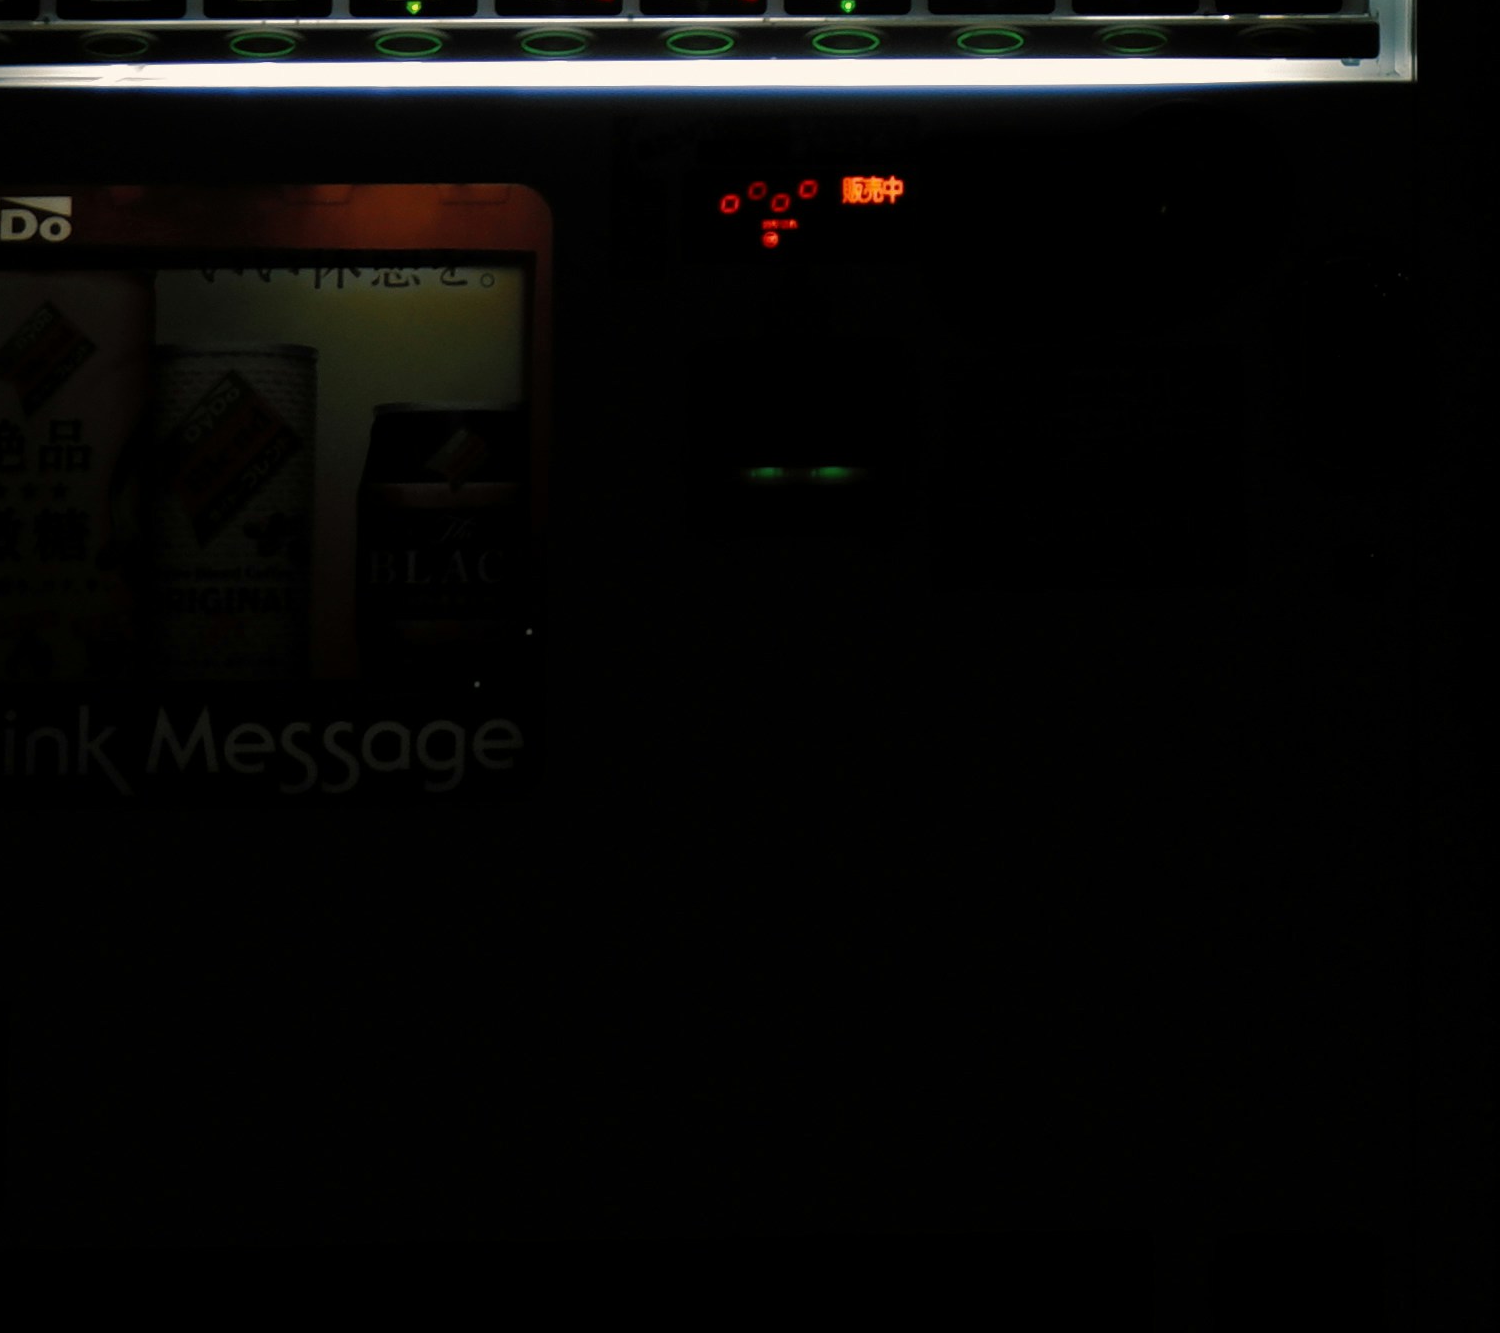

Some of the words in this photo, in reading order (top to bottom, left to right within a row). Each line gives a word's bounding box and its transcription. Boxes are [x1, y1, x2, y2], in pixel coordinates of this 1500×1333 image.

[843, 176, 903, 204] 販売中
[144, 703, 525, 796] Message
